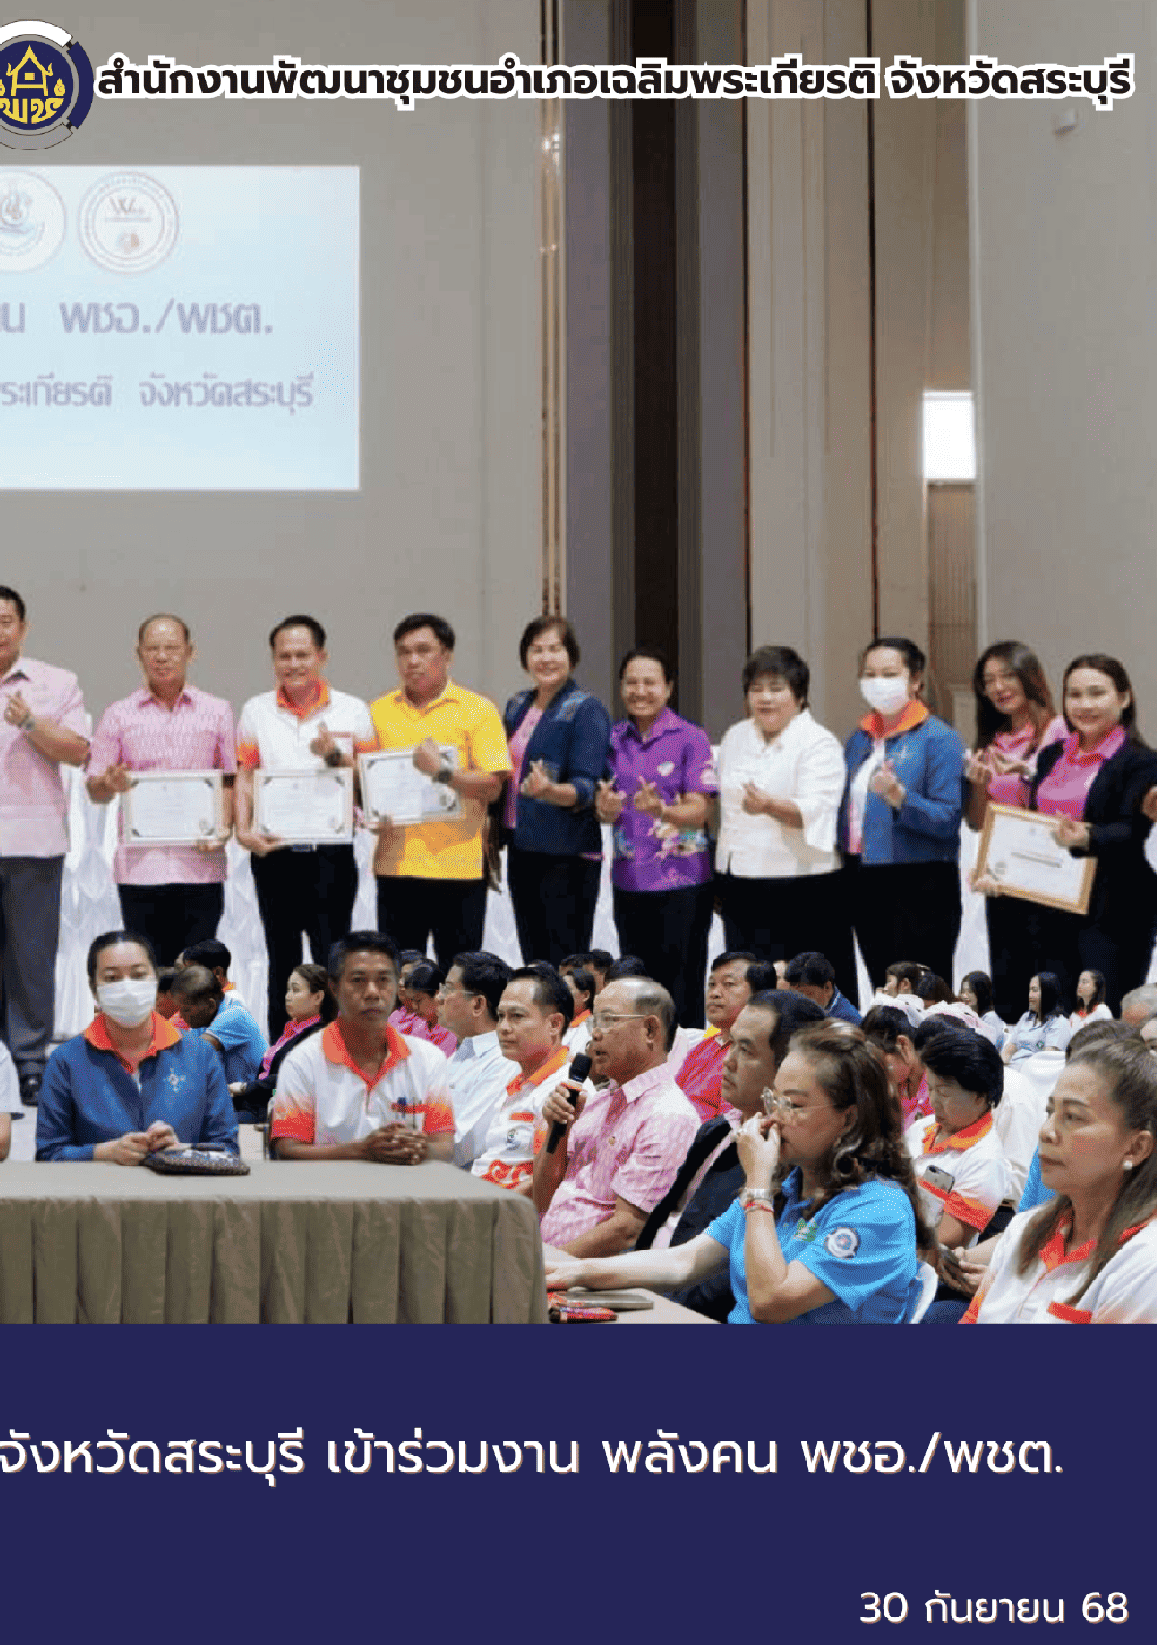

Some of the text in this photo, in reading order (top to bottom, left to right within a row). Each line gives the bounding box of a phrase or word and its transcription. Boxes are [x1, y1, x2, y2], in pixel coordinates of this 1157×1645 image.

[58, 298, 274, 334] พชอ./พชต.
[138, 371, 315, 416] จังหวัดสระบุรี
